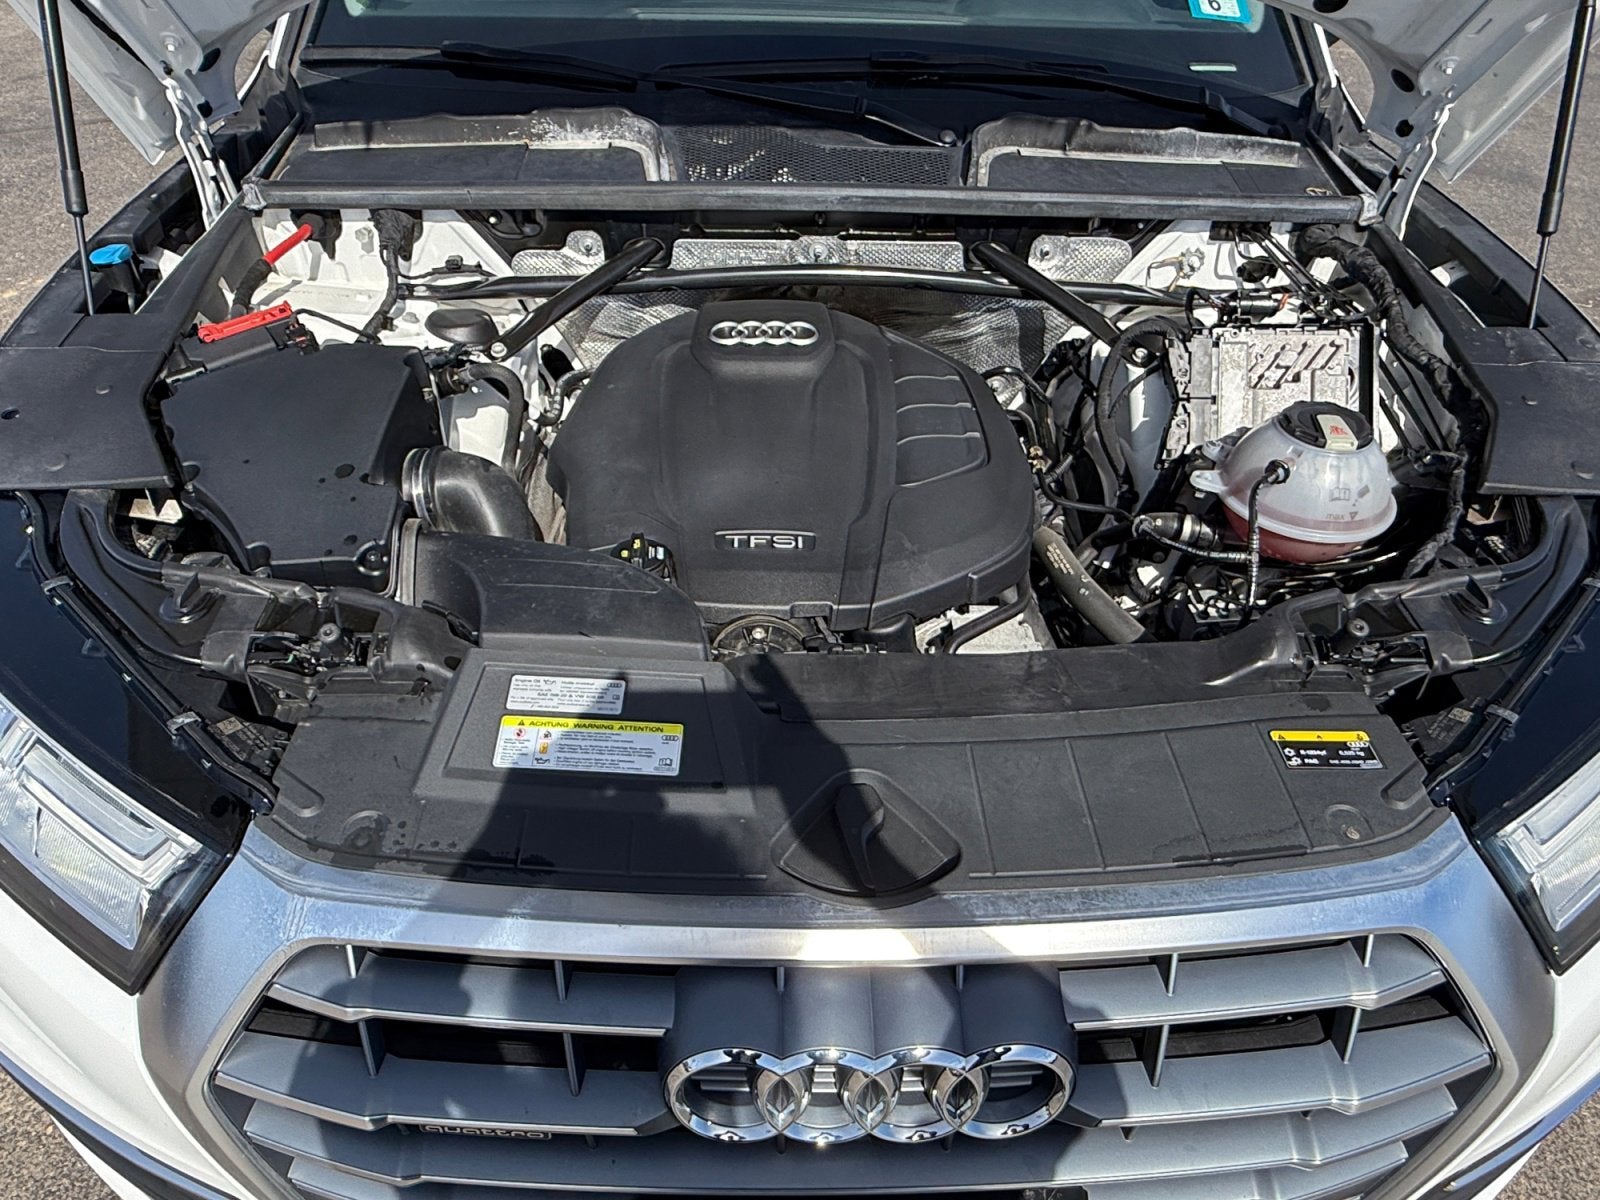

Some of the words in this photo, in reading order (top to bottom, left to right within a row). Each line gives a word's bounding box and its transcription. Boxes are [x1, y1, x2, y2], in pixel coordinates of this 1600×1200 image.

[725, 535, 803, 549] TFSI
[528, 720, 569, 728] ACHTUNG
[573, 722, 614, 730] WARNING
[618, 724, 664, 733] ATTENTION
[425, 1125, 544, 1138] quattro
